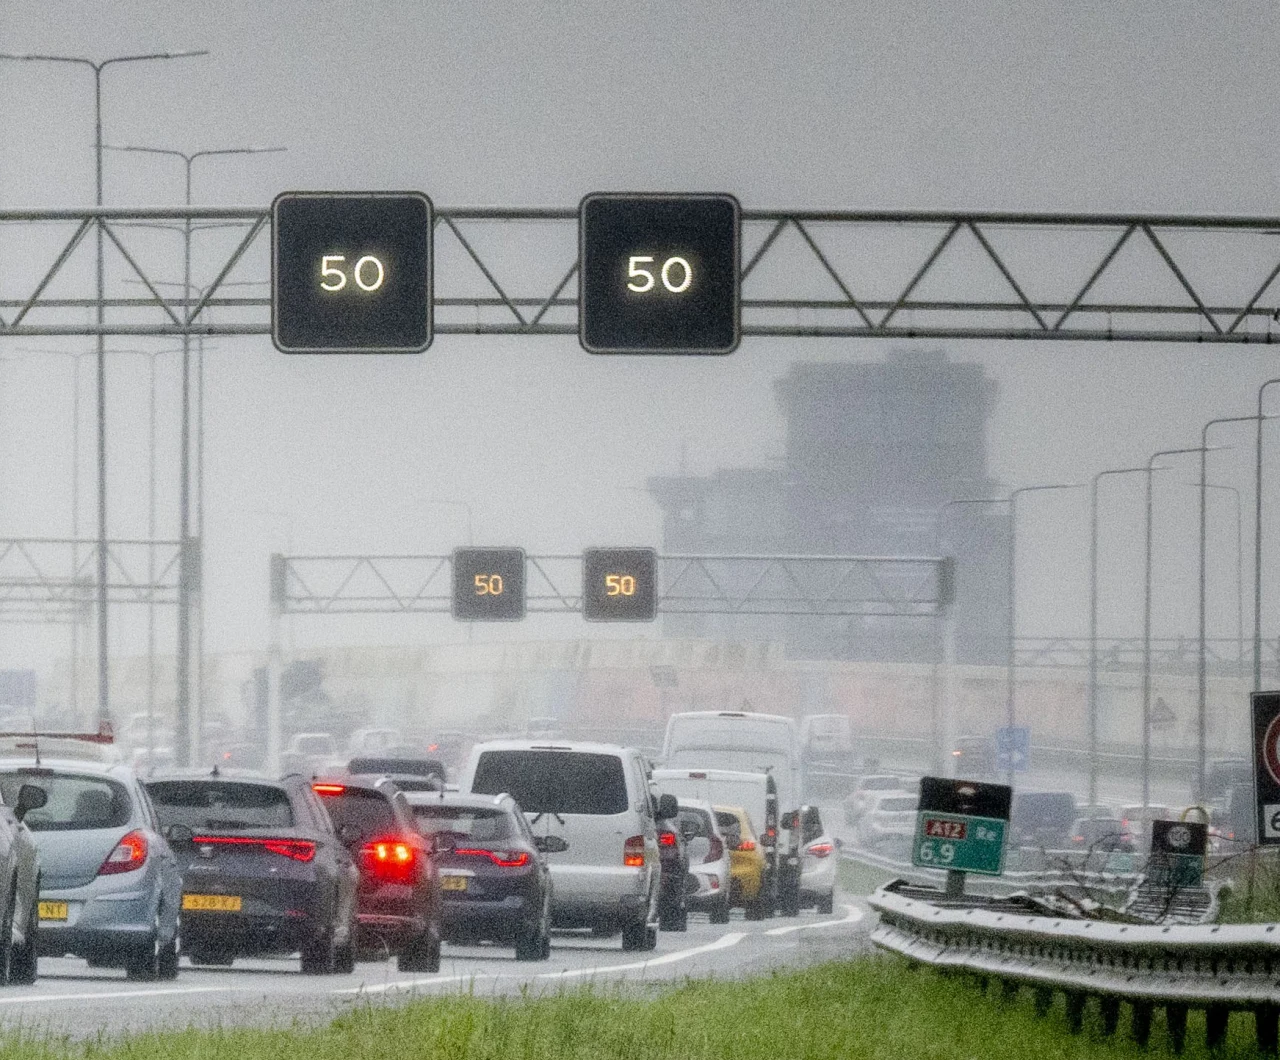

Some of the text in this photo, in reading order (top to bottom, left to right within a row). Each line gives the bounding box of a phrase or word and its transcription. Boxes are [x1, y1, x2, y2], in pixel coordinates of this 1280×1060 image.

[319, 254, 385, 293] 50
[626, 254, 693, 294] 50
[473, 573, 504, 596] 50
[605, 573, 637, 596] 50
[930, 820, 997, 841] A12 Re
